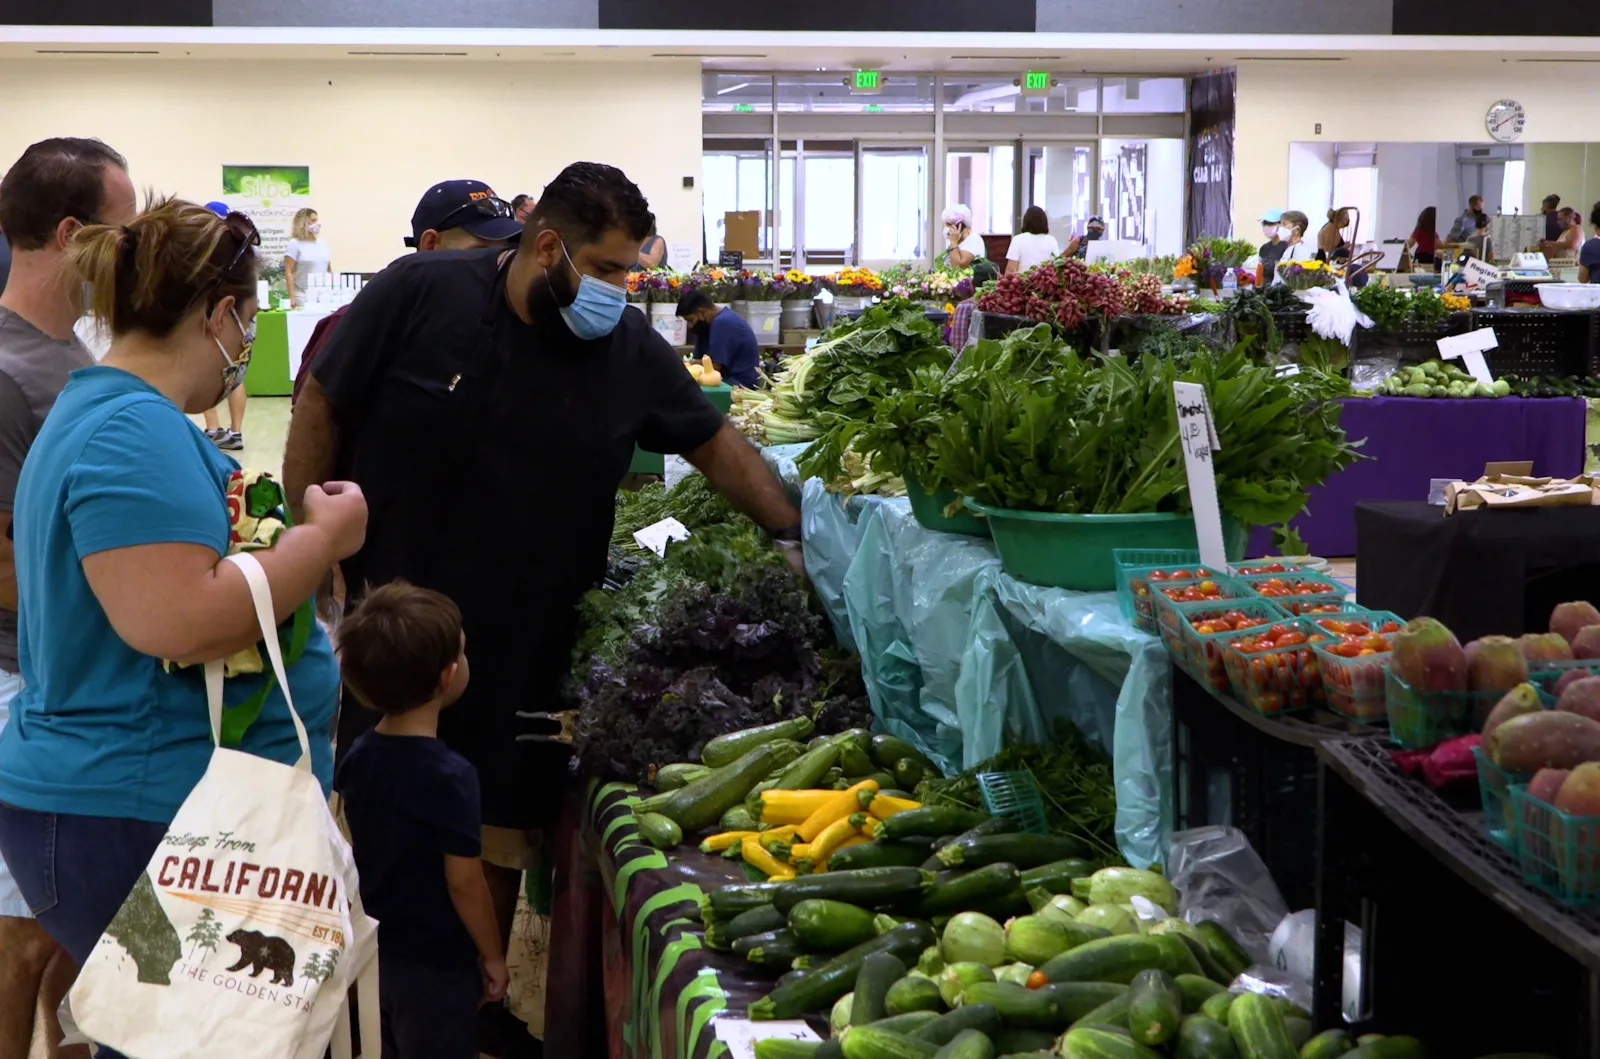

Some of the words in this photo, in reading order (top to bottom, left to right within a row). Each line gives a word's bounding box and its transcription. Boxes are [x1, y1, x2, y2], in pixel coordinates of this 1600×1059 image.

[856, 72, 878, 88] EXIT
[1026, 72, 1048, 89] EXIT
[1470, 262, 1498, 279] Registe
[163, 832, 210, 852] reetings
[214, 831, 256, 853] From
[157, 855, 339, 910] CALIFORNI
[312, 925, 330, 940] EST
[180, 963, 209, 981] THE
[213, 974, 279, 1002] GOLDEN
